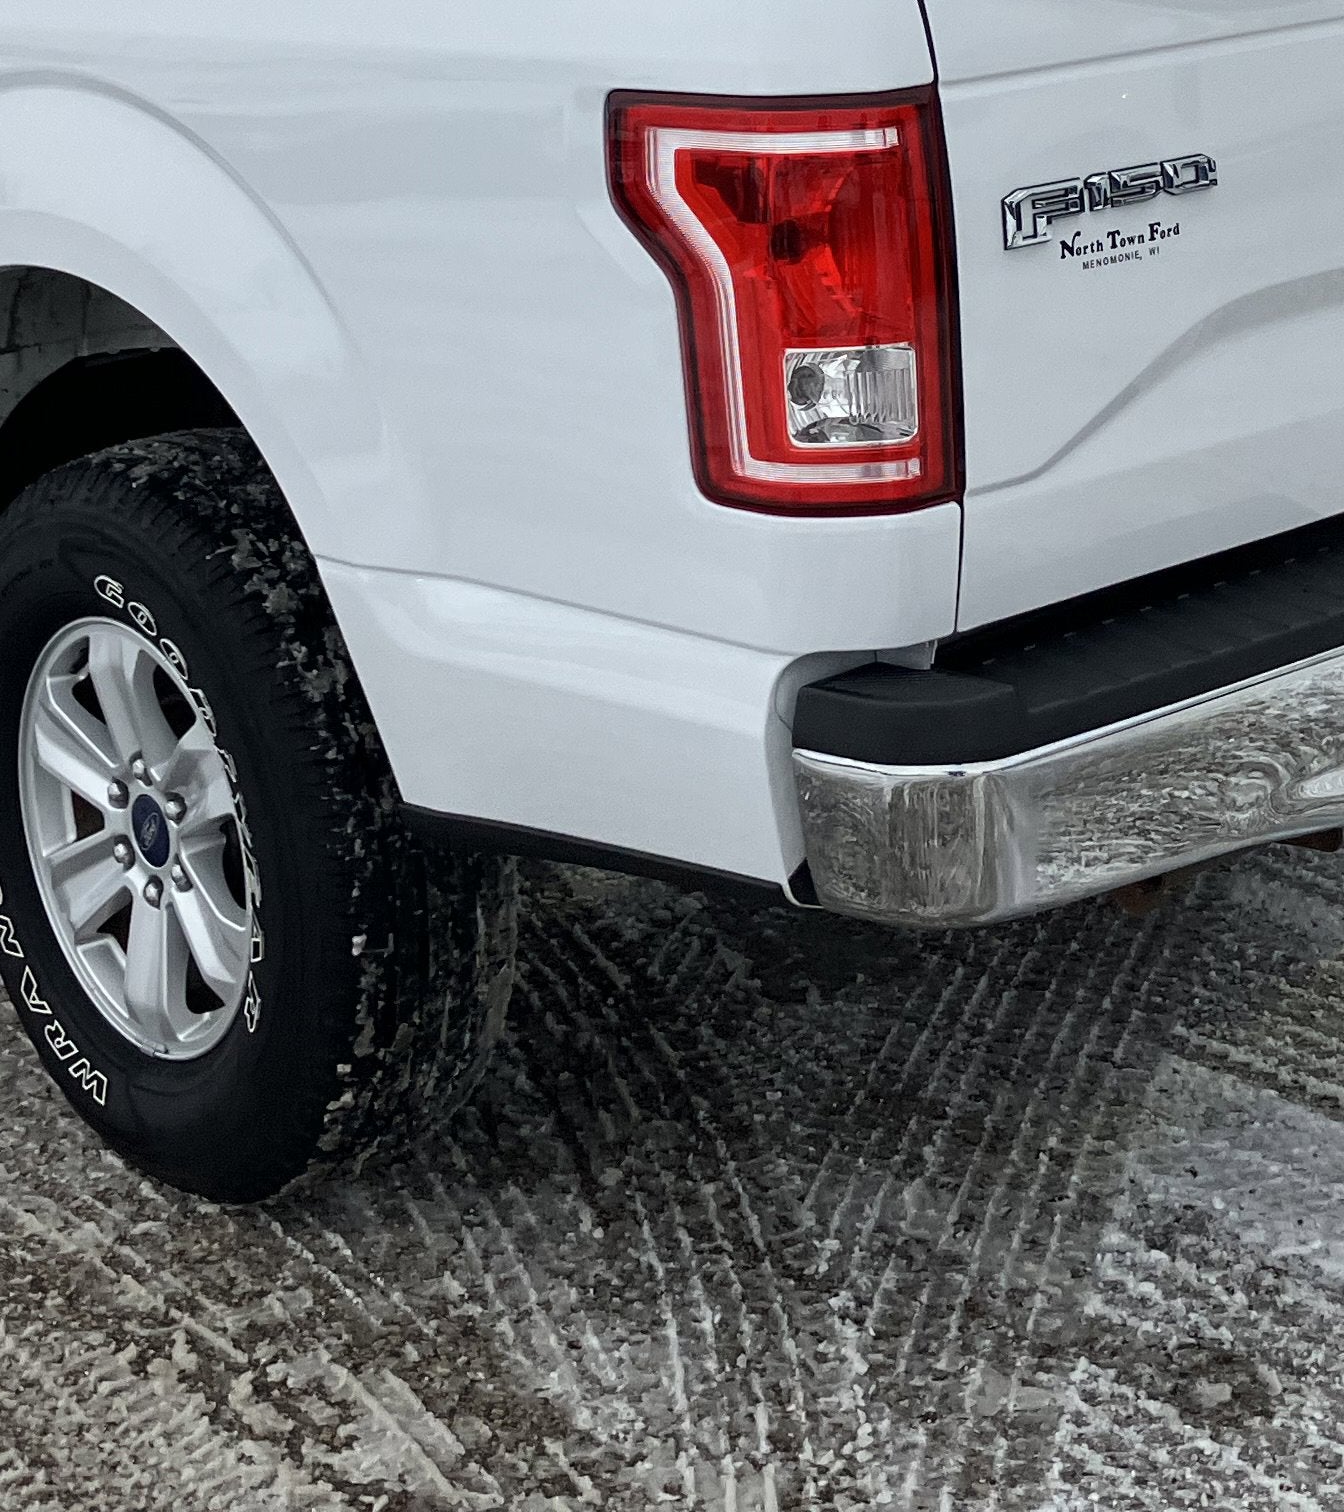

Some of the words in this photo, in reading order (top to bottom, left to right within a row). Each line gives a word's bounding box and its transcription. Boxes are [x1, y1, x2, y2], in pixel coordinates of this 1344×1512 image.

[1060, 231, 1104, 259] North
[1106, 229, 1145, 250] Town
[1148, 221, 1181, 242] Ford
[1082, 250, 1143, 270] MENOMONIE,
[1149, 246, 1161, 256] WI
